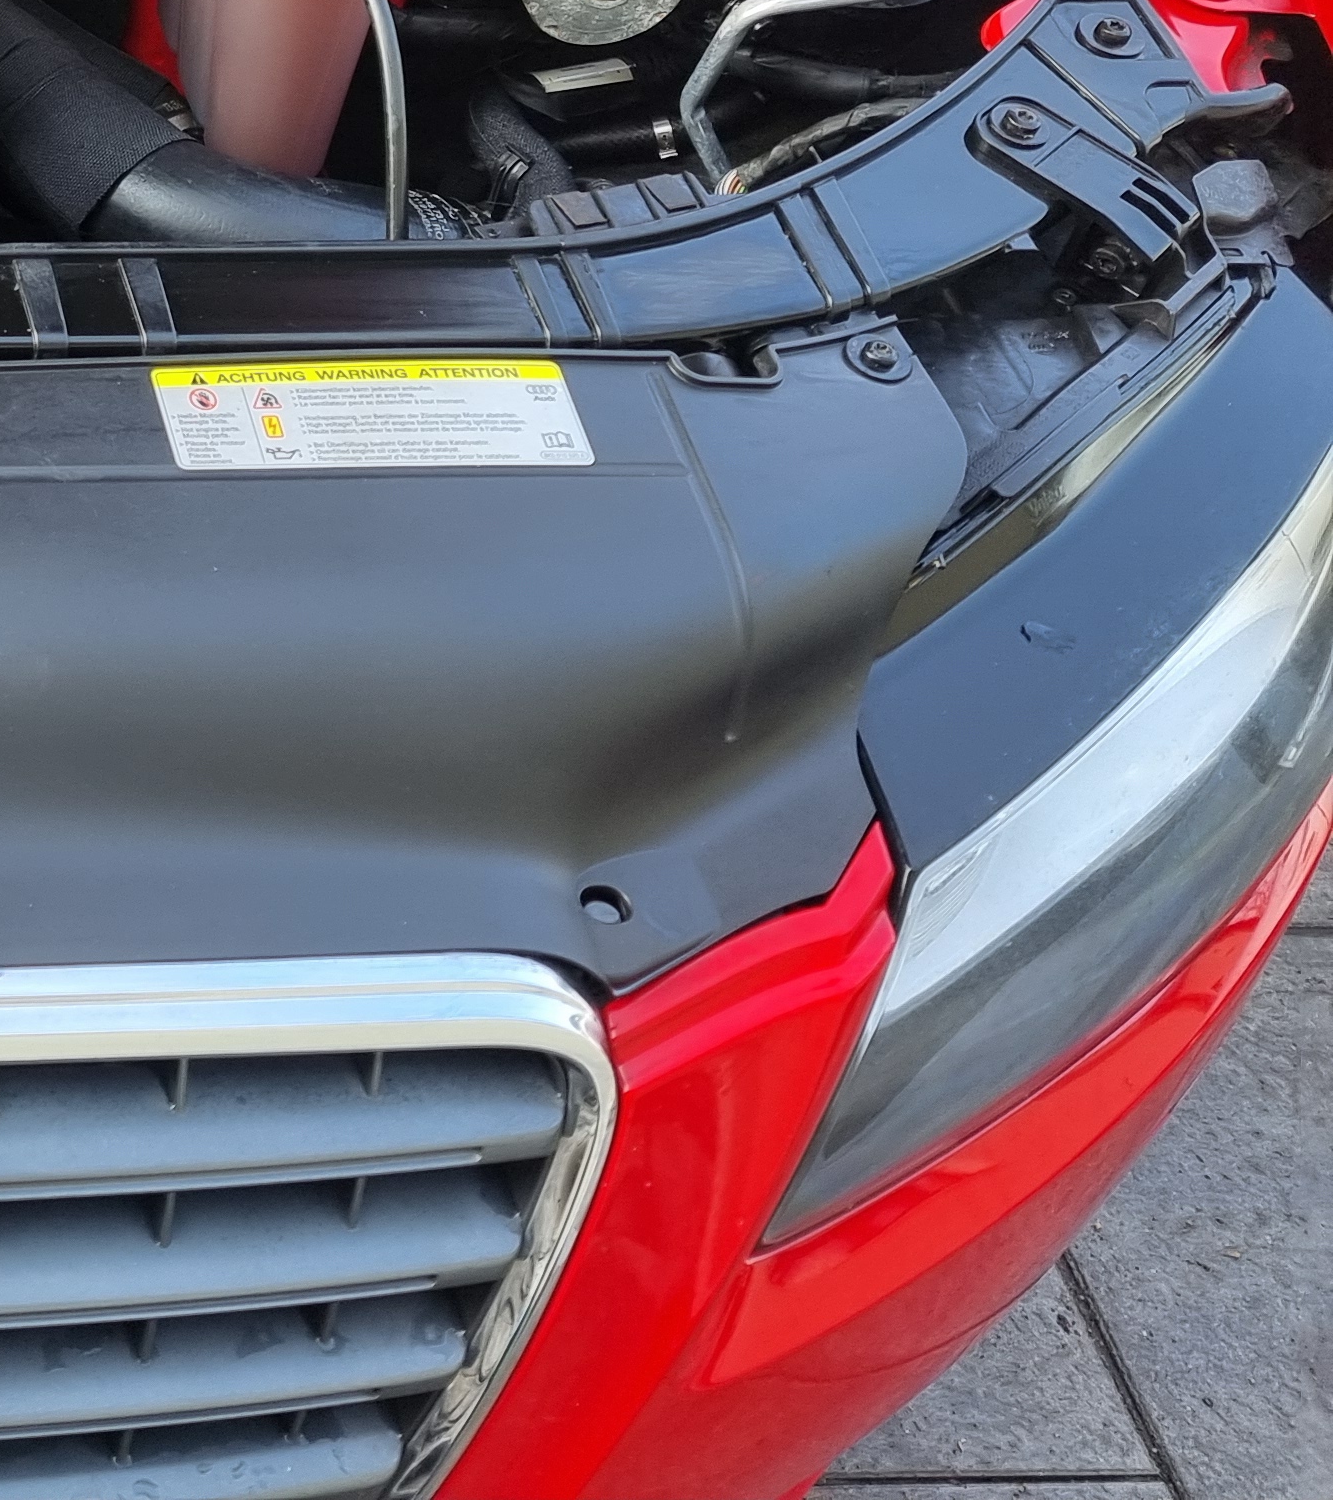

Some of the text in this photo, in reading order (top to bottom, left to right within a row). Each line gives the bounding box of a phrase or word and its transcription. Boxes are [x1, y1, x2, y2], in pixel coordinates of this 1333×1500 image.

[217, 367, 520, 384] ACHTUNG WARNING ATTENTION
